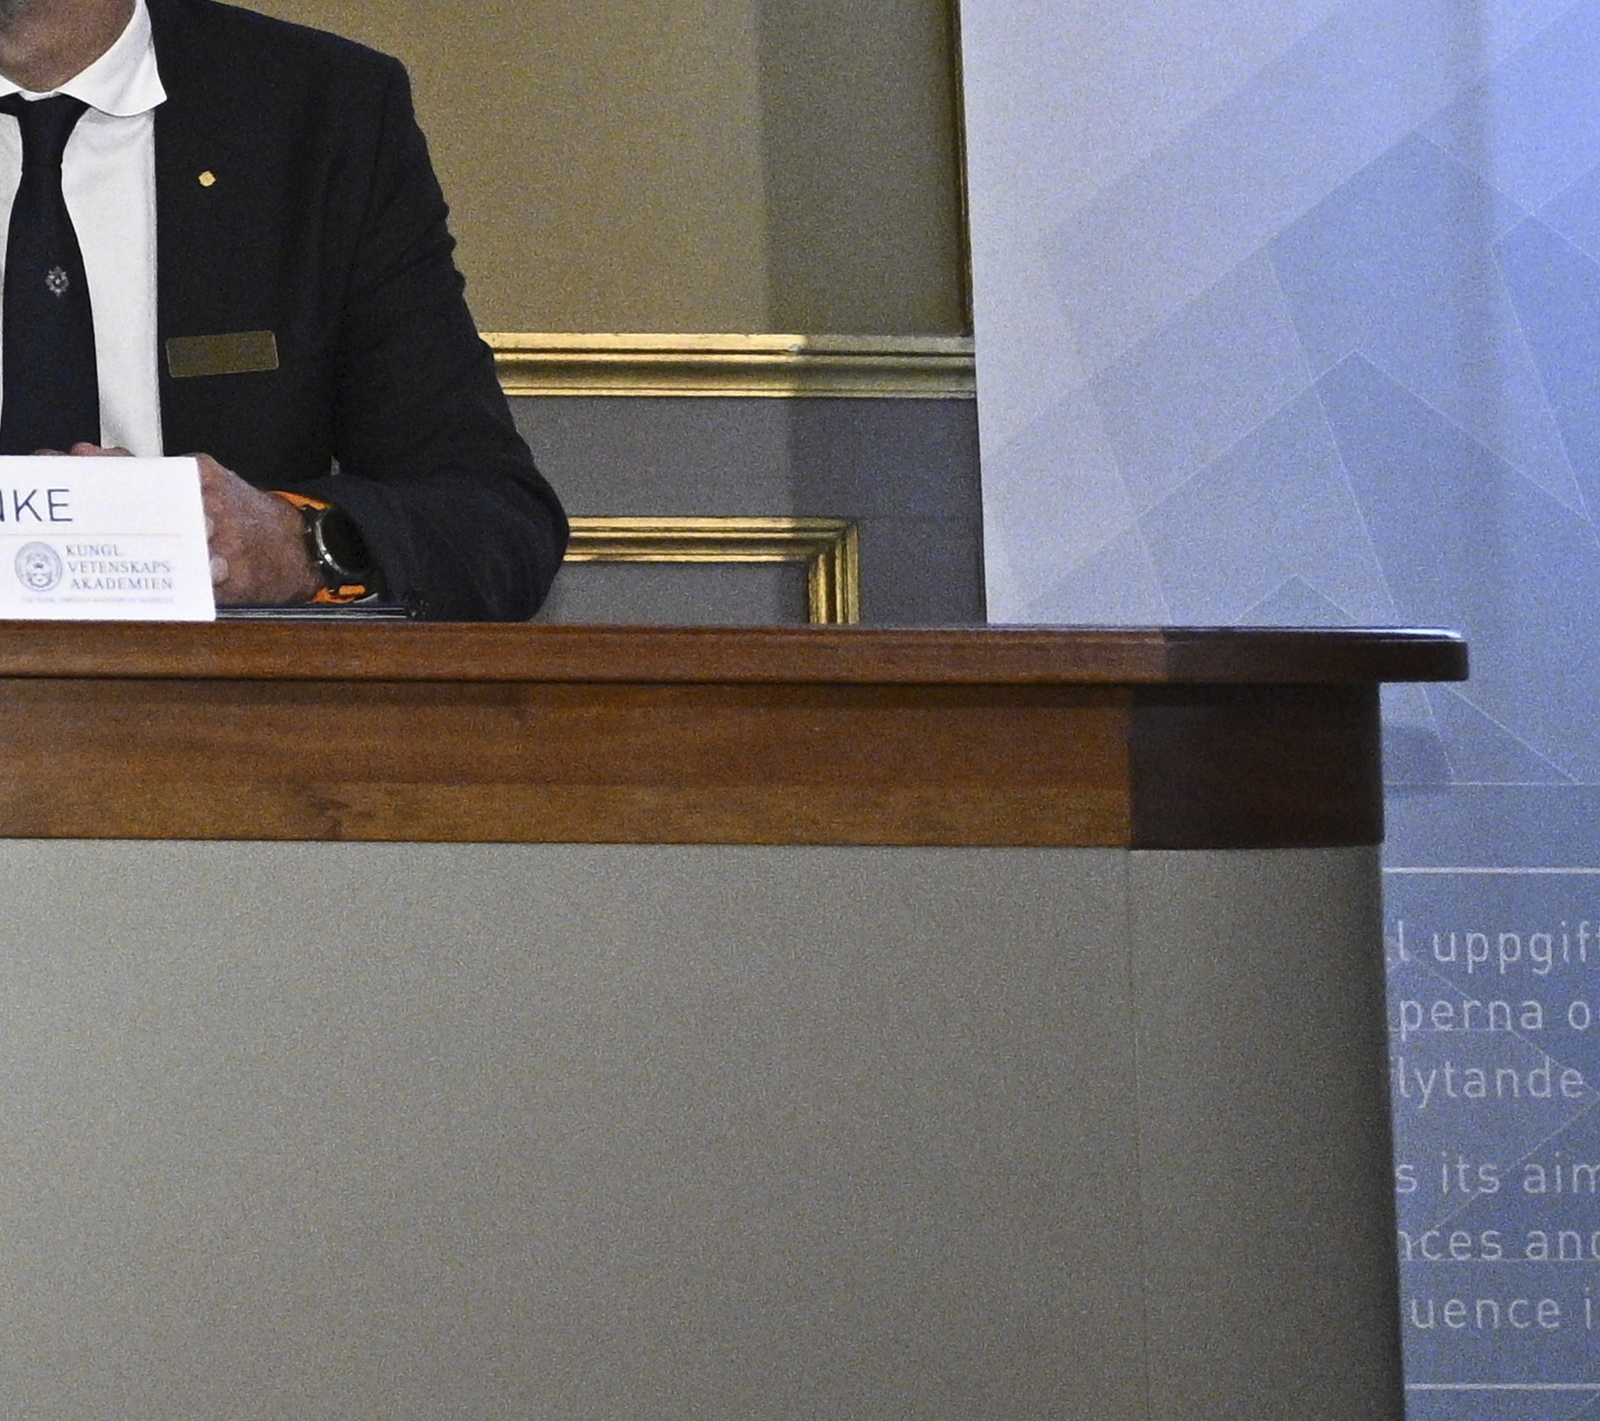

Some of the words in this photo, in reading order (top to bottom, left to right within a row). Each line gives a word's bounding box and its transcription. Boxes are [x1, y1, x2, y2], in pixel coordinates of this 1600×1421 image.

[1434, 920, 1600, 974] uppgif
[1400, 1000, 1543, 1041] perna
[1391, 1056, 1583, 1108] lytande
[1441, 1151, 1499, 1194] its
[1412, 1298, 1560, 1329] uence
